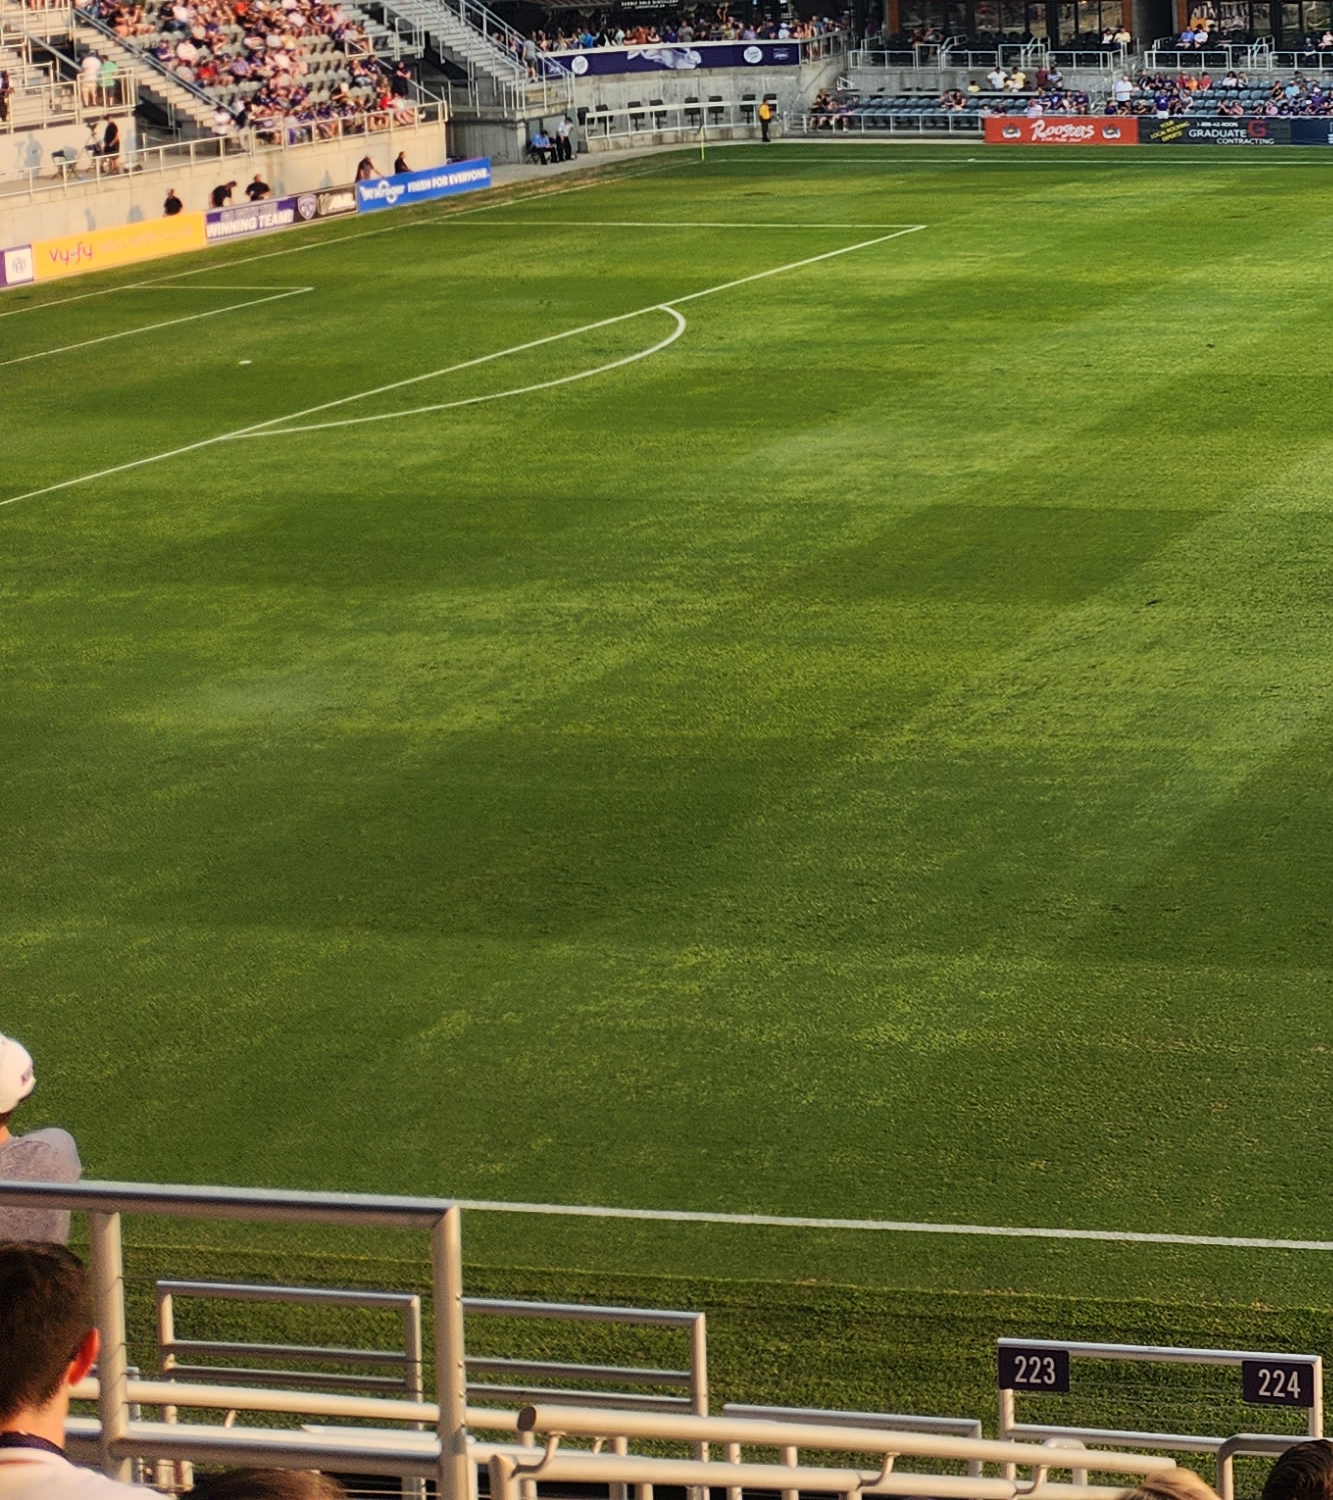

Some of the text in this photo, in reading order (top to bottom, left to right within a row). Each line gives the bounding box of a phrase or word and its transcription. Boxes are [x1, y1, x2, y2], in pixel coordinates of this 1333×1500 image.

[1030, 119, 1095, 141] Roosters
[1188, 129, 1248, 138] GRADUATE
[432, 177, 448, 188] FOR
[206, 215, 257, 238] WINNING
[1014, 1355, 1056, 1385] 223
[1257, 1368, 1301, 1399] 224
